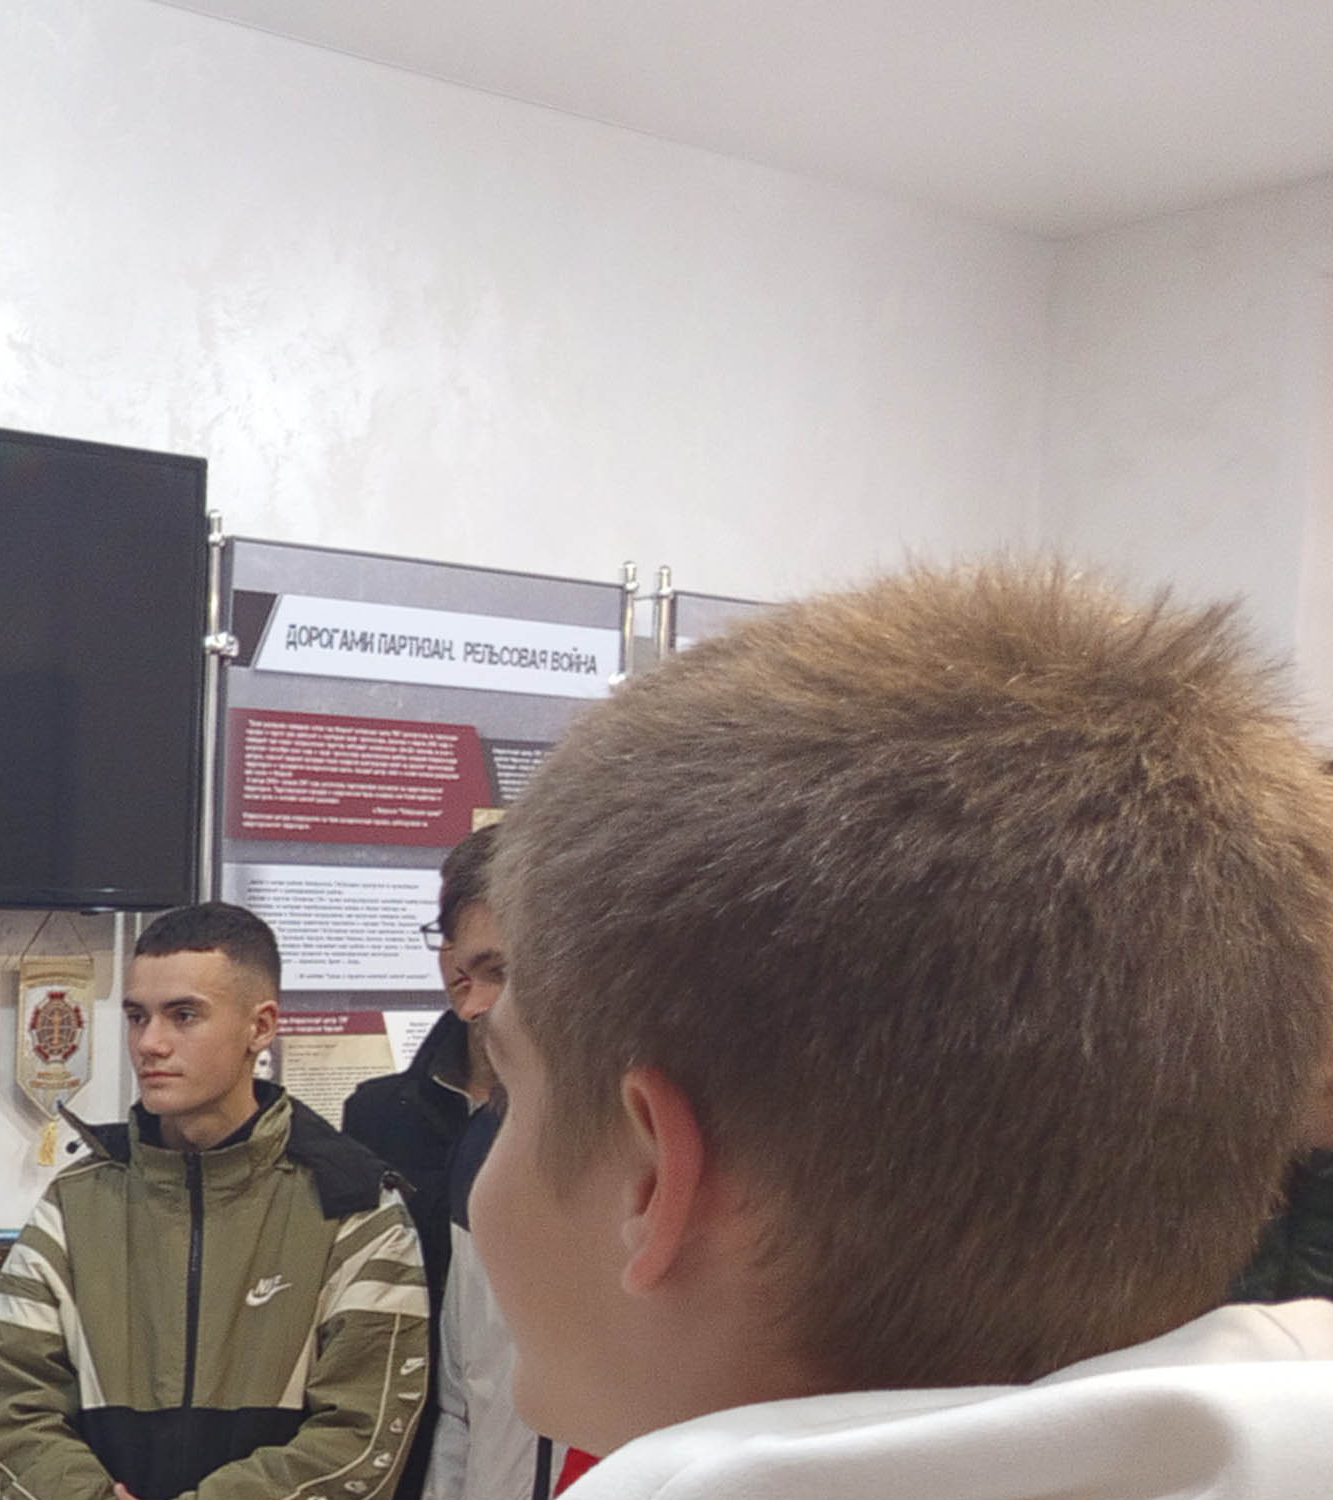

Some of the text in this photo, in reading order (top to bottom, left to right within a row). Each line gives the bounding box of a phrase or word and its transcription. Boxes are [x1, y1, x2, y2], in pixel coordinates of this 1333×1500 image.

[286, 624, 597, 675] ДОРОГАМИ ПАРТИЗАН. РЕЛЬСОВАЯ ВОЙНА
